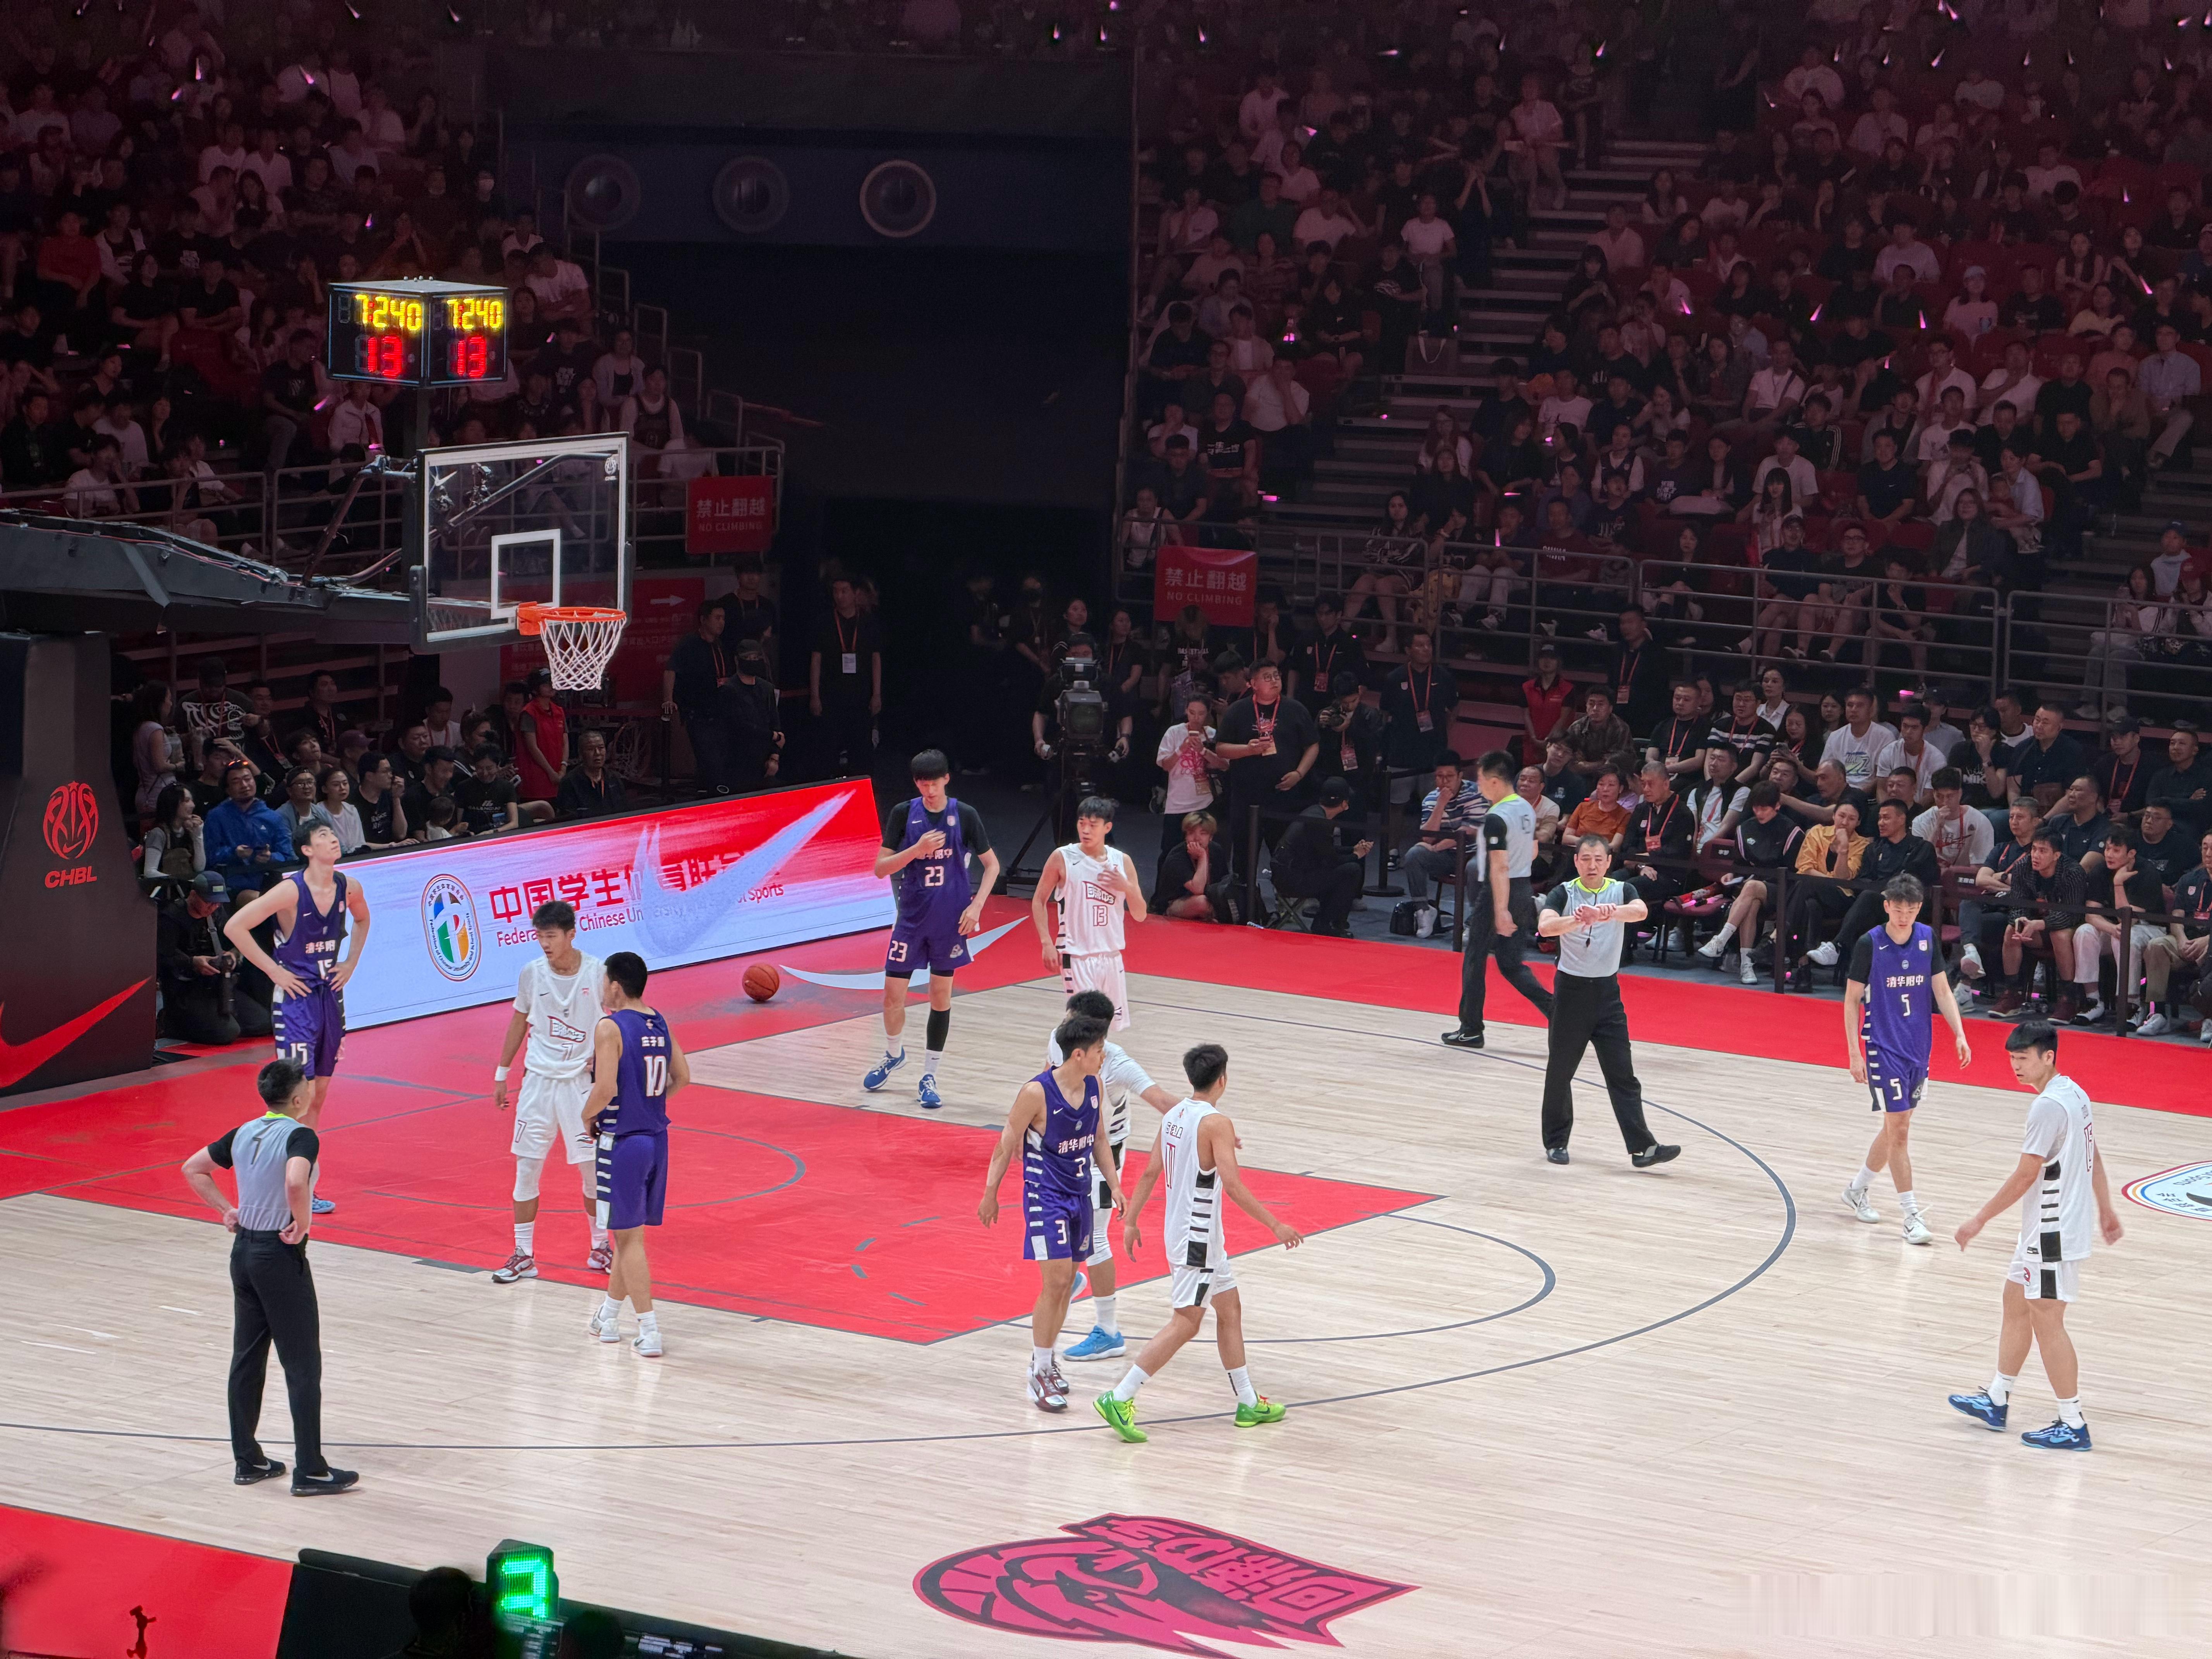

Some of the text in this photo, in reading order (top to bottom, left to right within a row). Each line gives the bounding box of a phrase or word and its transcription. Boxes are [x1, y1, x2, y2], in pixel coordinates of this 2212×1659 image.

[368, 334, 402, 378] 13
[457, 335, 486, 378] 13
[696, 496, 766, 518] 禁止翻越
[699, 521, 762, 532] NO CLIMBING
[1165, 567, 1247, 591] 禁止翻越
[1167, 591, 1242, 605] NO CLIMBING
[1963, 773, 1987, 784] NIK
[45, 866, 97, 888] CHBL
[925, 866, 944, 887] 23
[579, 912, 625, 931] Chinese
[1092, 905, 1108, 927] 13
[888, 940, 908, 962] 23
[1901, 994, 1910, 1017] 5
[290, 1042, 308, 1065] 15
[562, 1043, 574, 1062] 7
[644, 1055, 666, 1097] 10
[1890, 1078, 1902, 1100] 5
[515, 1119, 527, 1143] 7
[252, 1137, 263, 1165] 7
[1055, 1219, 1067, 1245] 3
